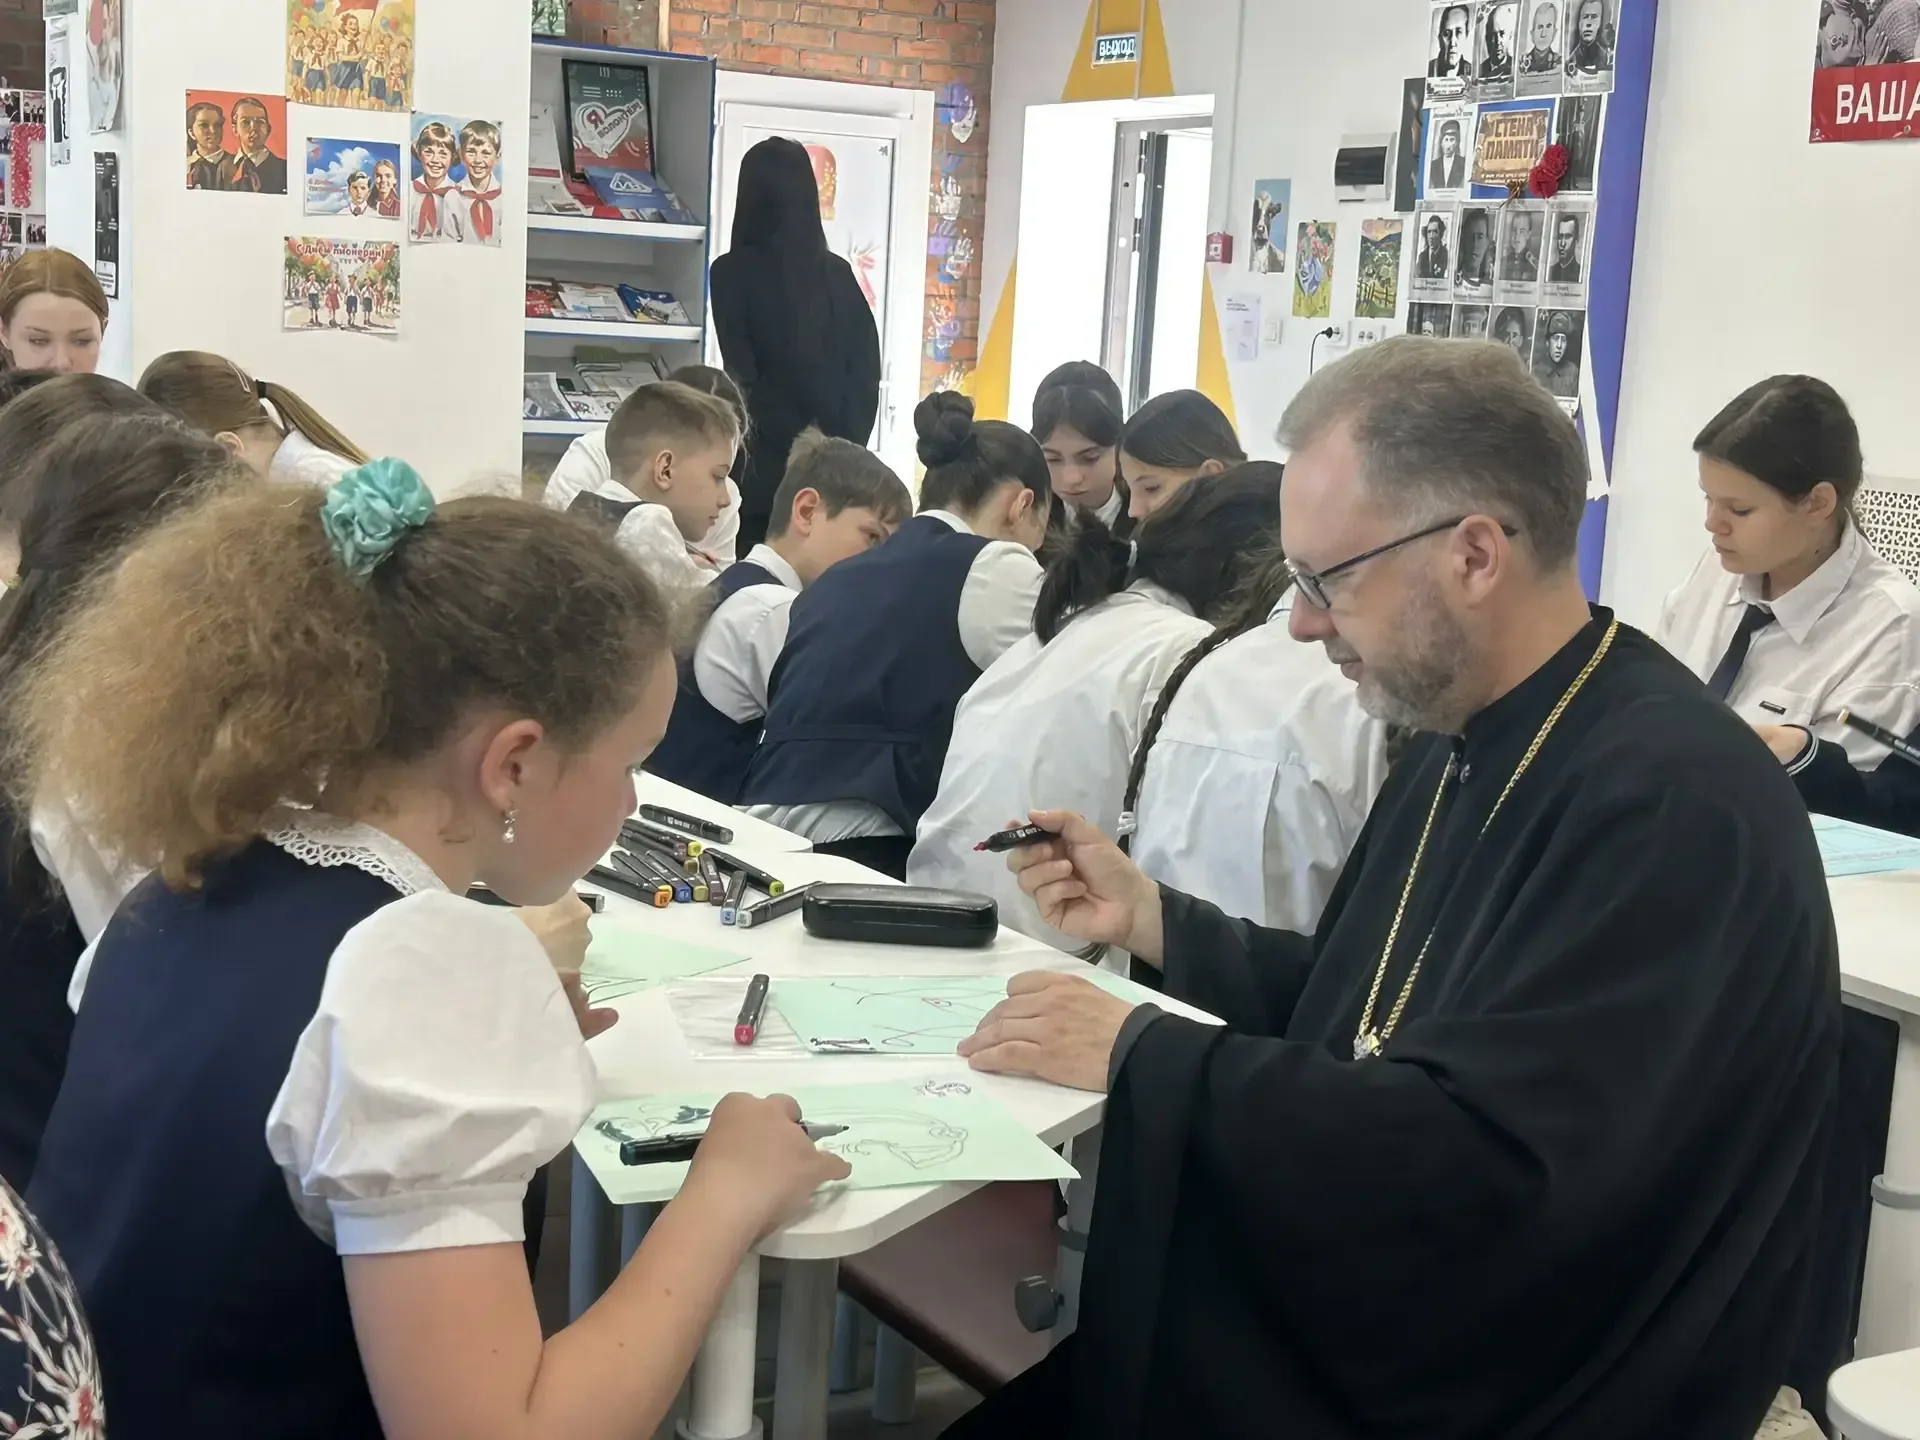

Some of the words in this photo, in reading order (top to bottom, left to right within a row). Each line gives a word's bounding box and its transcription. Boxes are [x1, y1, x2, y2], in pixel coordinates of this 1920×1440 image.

[1099, 38, 1135, 57] ВЫХОД
[1836, 80, 1920, 124] ВАША
[586, 109, 605, 130] Я
[1494, 116, 1536, 138] СТЕНА
[1485, 138, 1542, 160] ПАМЯТИ
